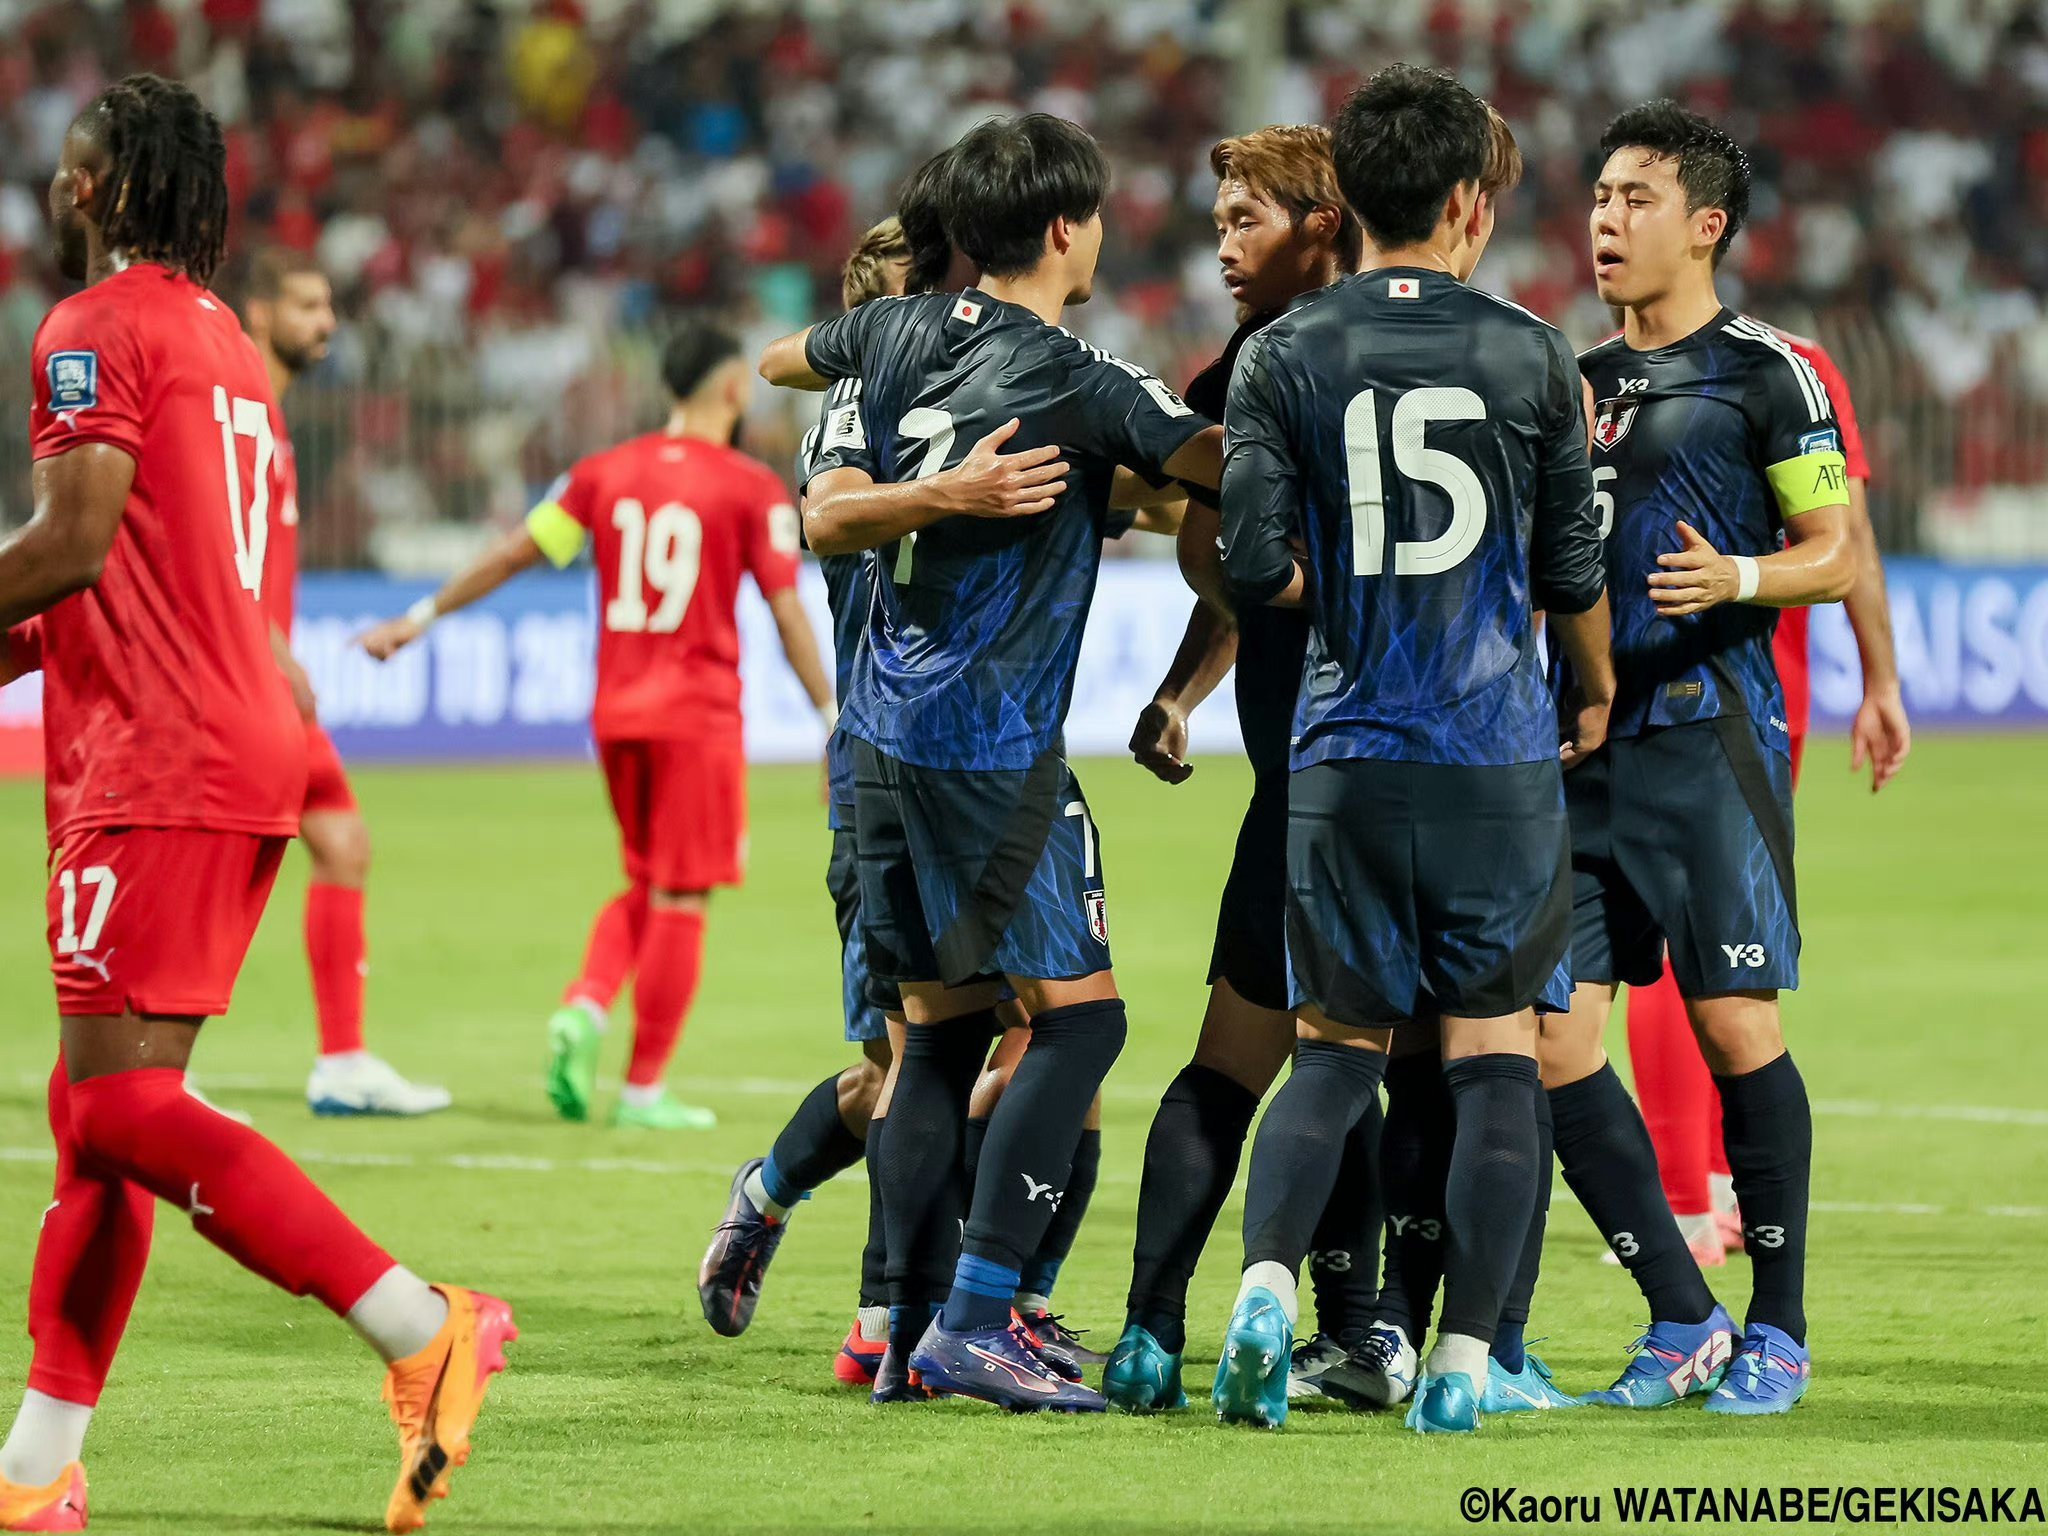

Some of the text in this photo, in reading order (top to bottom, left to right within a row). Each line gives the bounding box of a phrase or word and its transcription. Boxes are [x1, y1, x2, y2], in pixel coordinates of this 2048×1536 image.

[213, 384, 275, 602] 17
[894, 406, 957, 586] 7
[1344, 386, 1488, 577] 15
[606, 497, 703, 634] 19
[1064, 801, 1095, 879] 7
[57, 865, 118, 954] 17
[1720, 943, 1766, 968] Y-3
[1389, 1214, 1442, 1241] Y-3
